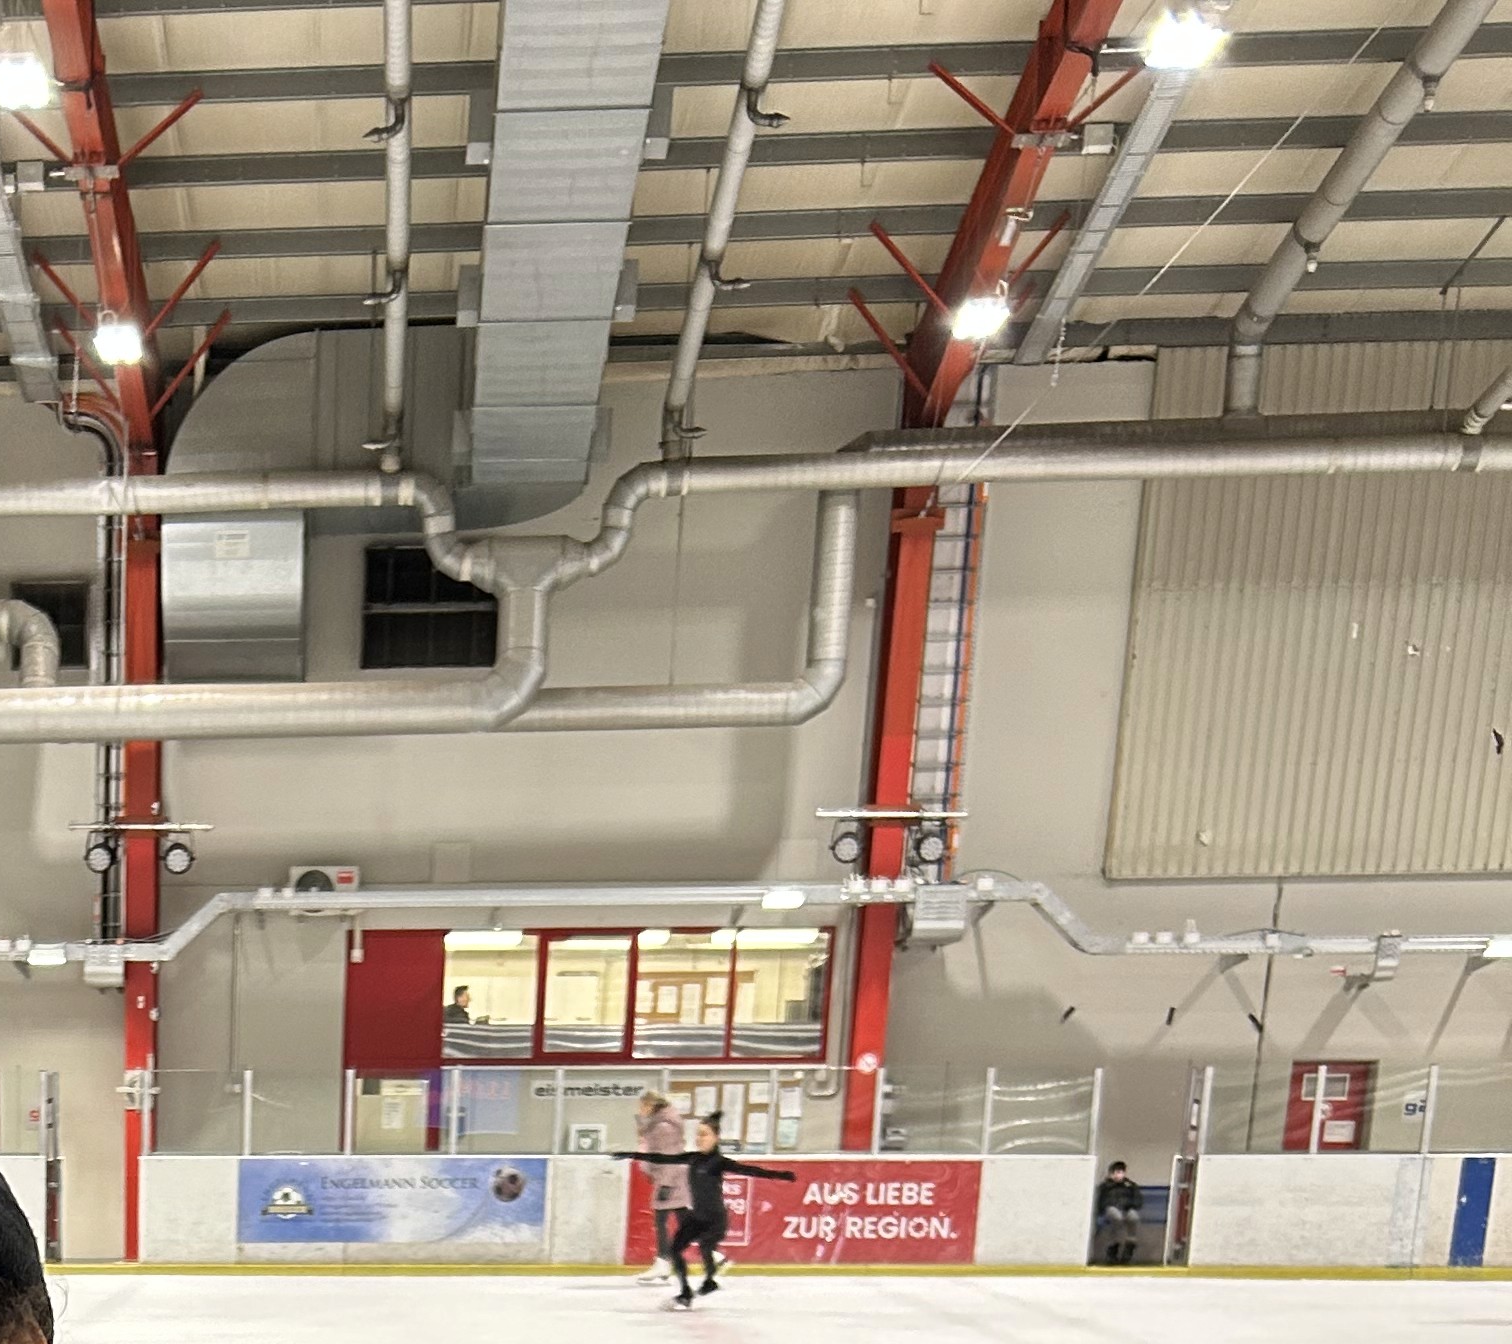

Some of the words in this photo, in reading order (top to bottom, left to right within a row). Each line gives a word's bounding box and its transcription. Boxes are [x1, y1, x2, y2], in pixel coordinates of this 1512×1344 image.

[420, 1175, 480, 1190] SOCCER
[802, 1182, 861, 1206] AUS
[865, 1182, 936, 1206] LIEBE
[781, 1215, 837, 1241] ZUR
[845, 1215, 958, 1240] REGION.
